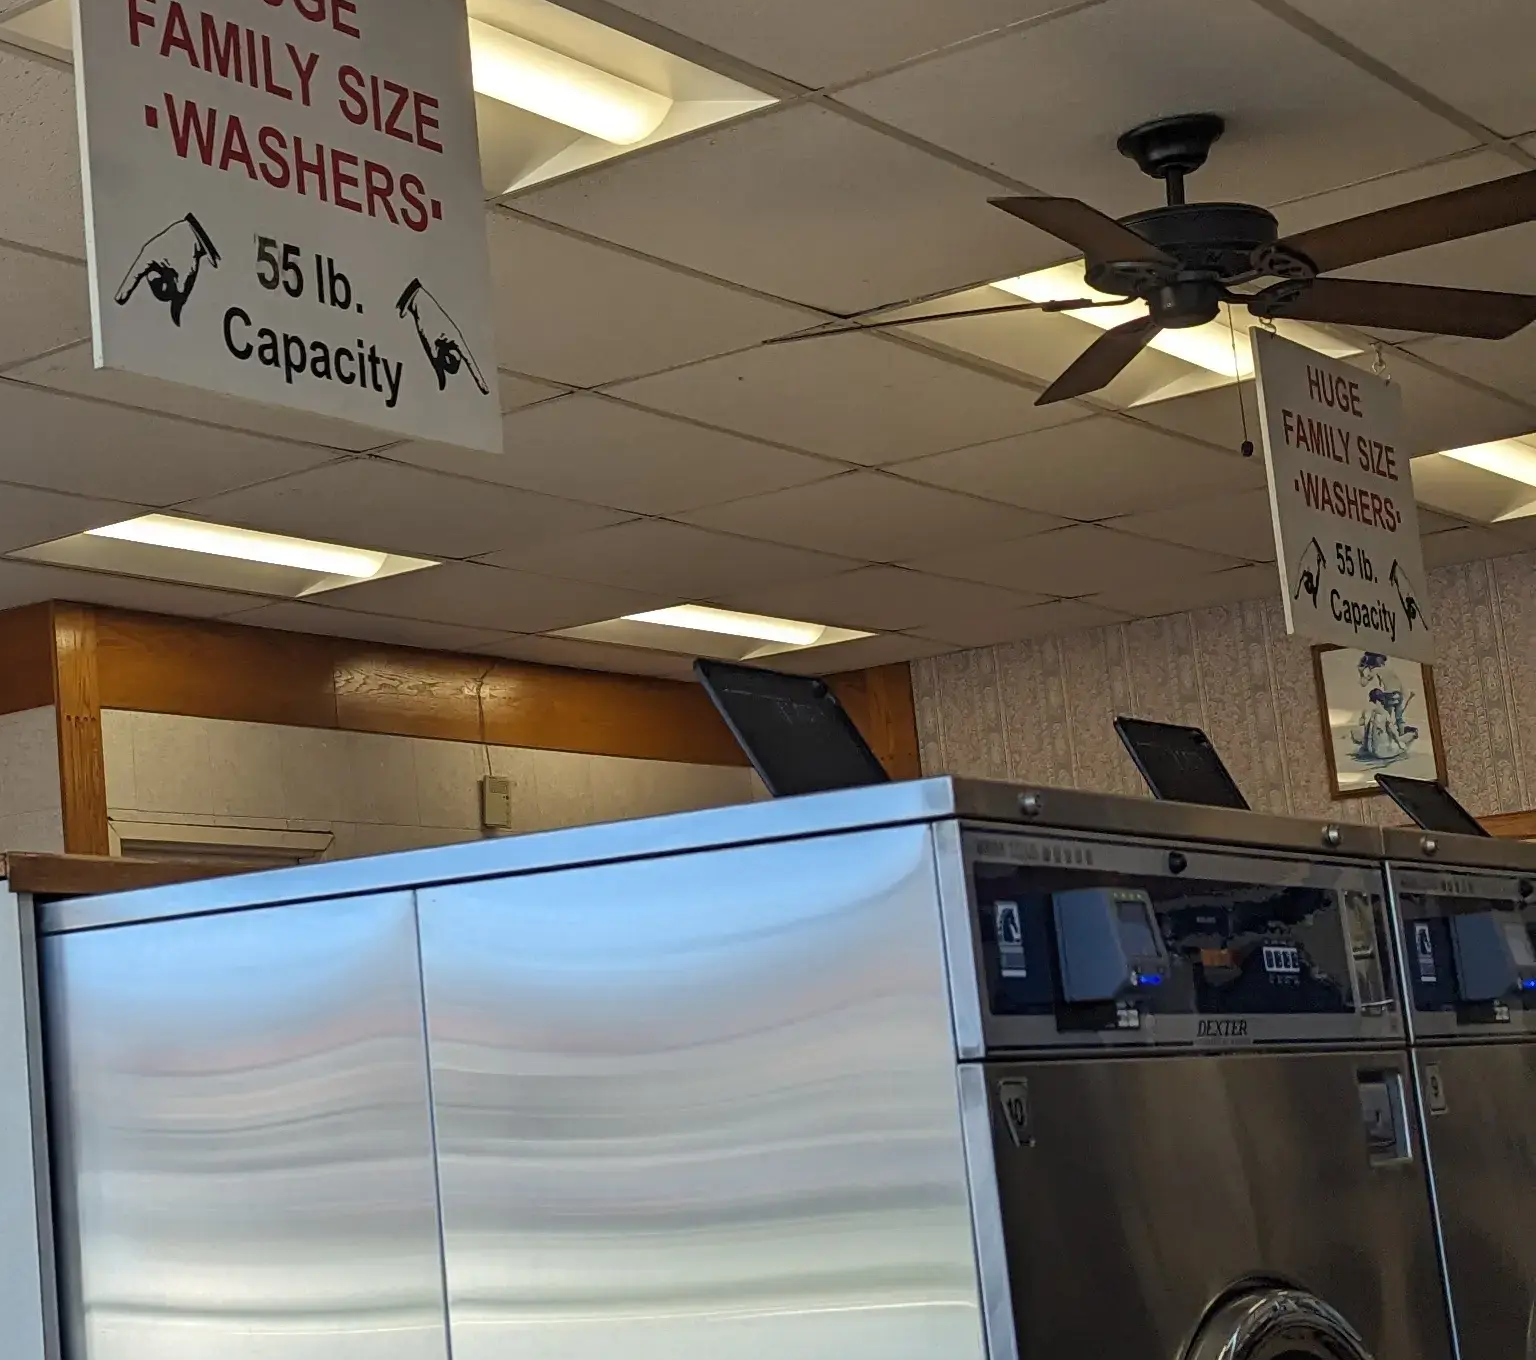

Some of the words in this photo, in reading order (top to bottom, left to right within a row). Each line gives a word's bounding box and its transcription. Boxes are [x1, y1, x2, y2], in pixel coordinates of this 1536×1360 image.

[338, 65, 443, 154] SIZE
[254, 234, 304, 298] 55
[316, 256, 364, 314] lb.
[224, 306, 403, 408] Capacity
[1307, 365, 1363, 418] HUGE
[1282, 409, 1351, 462] FAMILY
[1358, 438, 1399, 482] SIZE
[1335, 542, 1355, 577] 55
[1358, 550, 1378, 584] lb.
[1330, 588, 1396, 642] Capacity
[1197, 1019, 1248, 1037] DEXTER
